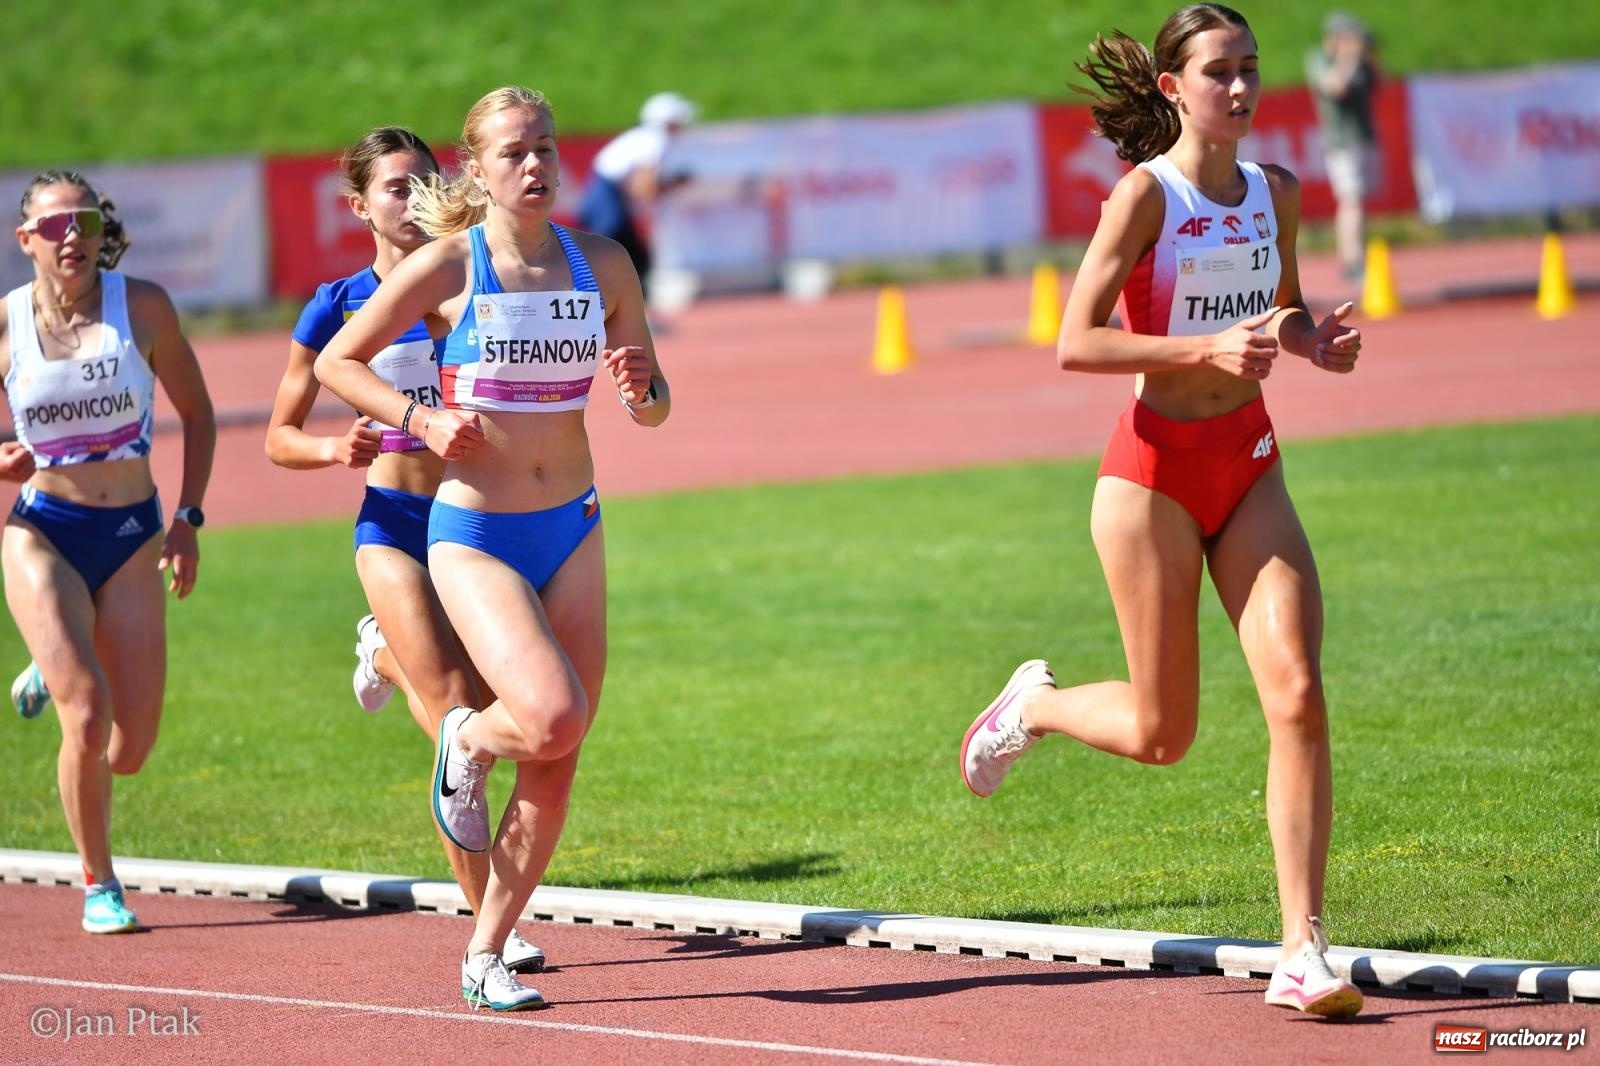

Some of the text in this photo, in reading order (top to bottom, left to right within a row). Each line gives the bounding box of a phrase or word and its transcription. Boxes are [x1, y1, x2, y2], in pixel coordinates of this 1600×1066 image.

[1177, 217, 1213, 237] 4F
[1223, 236, 1251, 245] ORLEN
[1251, 246, 1270, 271] 17
[549, 298, 590, 320] 117
[1184, 288, 1275, 321] THAMM
[484, 334, 597, 364] ŠTEFANOVÁ
[81, 357, 120, 381] 317
[25, 386, 134, 428] POPOVICOVÁ
[1252, 430, 1274, 459] 4F
